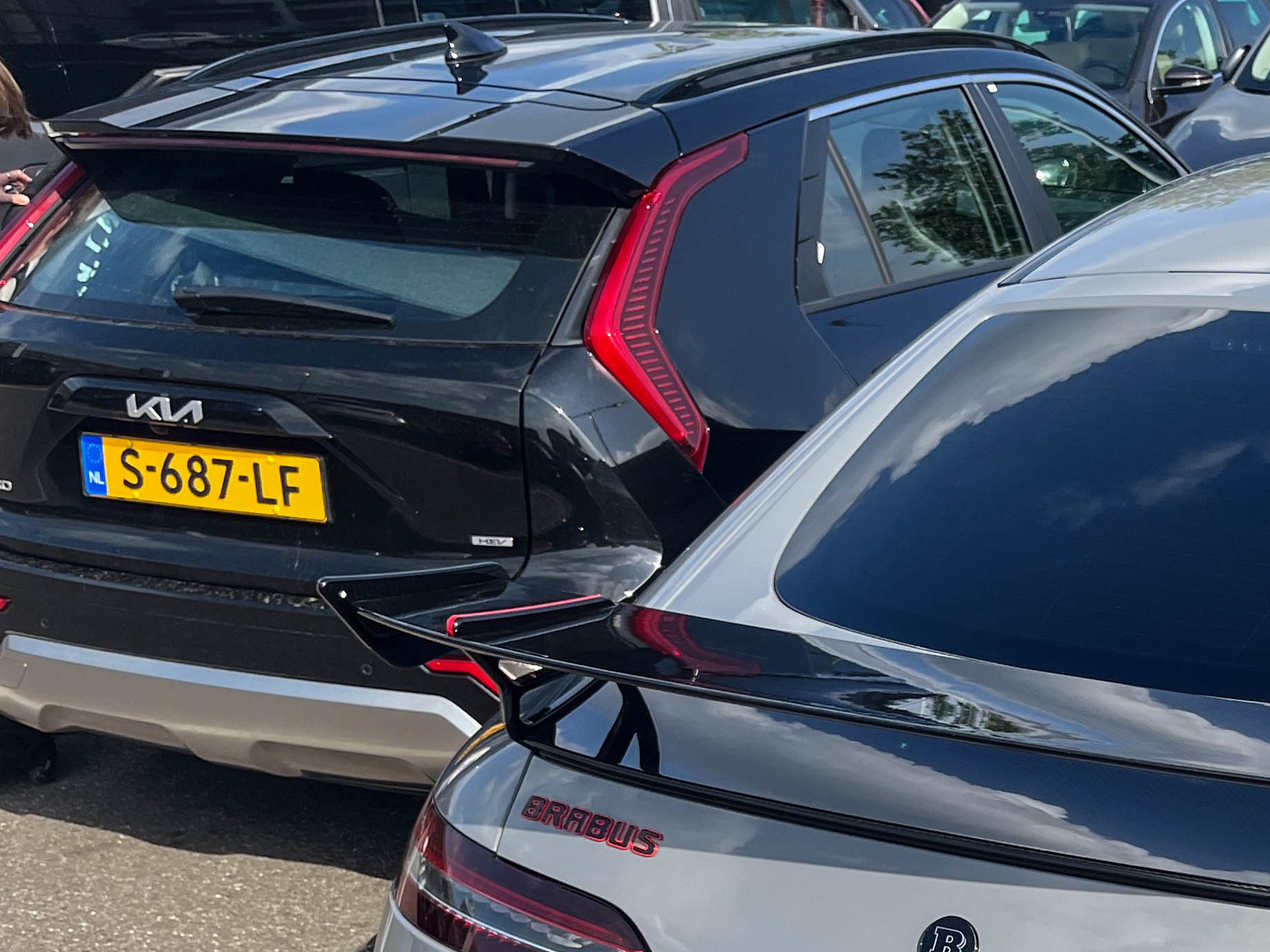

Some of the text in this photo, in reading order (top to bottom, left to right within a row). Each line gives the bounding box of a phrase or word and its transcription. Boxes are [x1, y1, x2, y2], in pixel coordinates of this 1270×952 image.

[126, 393, 204, 425] KIA
[88, 470, 105, 485] NL
[120, 448, 300, 507] S-687-LF
[478, 538, 507, 546] HEV
[520, 794, 664, 858] BRABUS
